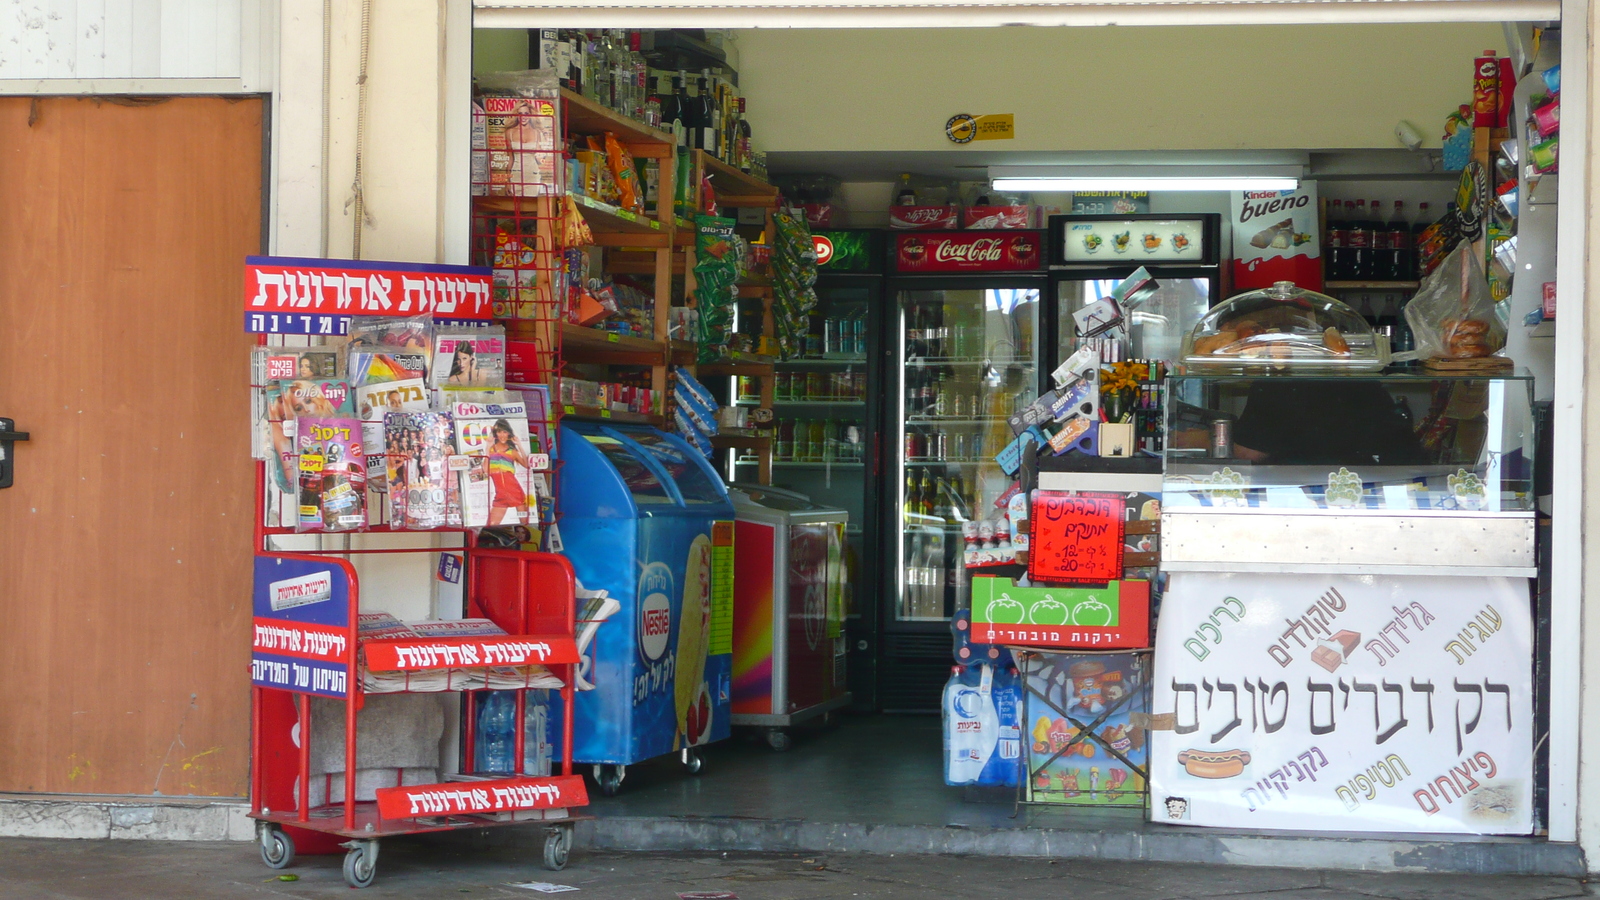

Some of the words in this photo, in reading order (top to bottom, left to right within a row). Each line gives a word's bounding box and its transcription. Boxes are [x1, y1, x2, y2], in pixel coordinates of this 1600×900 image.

[488, 118, 505, 126] SEX
[1239, 195, 1309, 223] bueno
[935, 238, 1004, 262] Coca-Cola
[252, 268, 393, 312] אחרונות
[398, 274, 490, 314] ידיעות
[252, 314, 352, 334] המדינה
[271, 360, 293, 369] פנאי
[271, 368, 293, 377] פלוס
[310, 425, 351, 441] דיסני
[277, 584, 304, 601] אחרונות
[305, 579, 328, 595] ידיעות
[254, 624, 302, 651] אחרונות
[987, 630, 1060, 641] מובחרים
[1071, 632, 1121, 645] ירקות
[1183, 596, 1247, 662] כריכים
[1267, 586, 1347, 668] שוקולדים
[1364, 601, 1436, 667] גלידות
[1443, 604, 1503, 666] עוגיות
[303, 629, 346, 657] ידיעות
[395, 643, 481, 667] אחרונות
[481, 641, 552, 664] ידיעות
[252, 659, 289, 684] המדינה
[293, 662, 310, 687] של
[313, 667, 347, 693] העיתון
[1172, 676, 1289, 744] טובים
[1308, 676, 1435, 745] דברים
[1453, 676, 1513, 757] רק
[957, 721, 982, 730] נביעות
[1240, 746, 1330, 813] נקניקיות
[1335, 753, 1412, 813] חטיפים
[1413, 750, 1498, 817] פיצוחים
[406, 787, 492, 814] אחרונות
[491, 784, 561, 808] ידיעות
